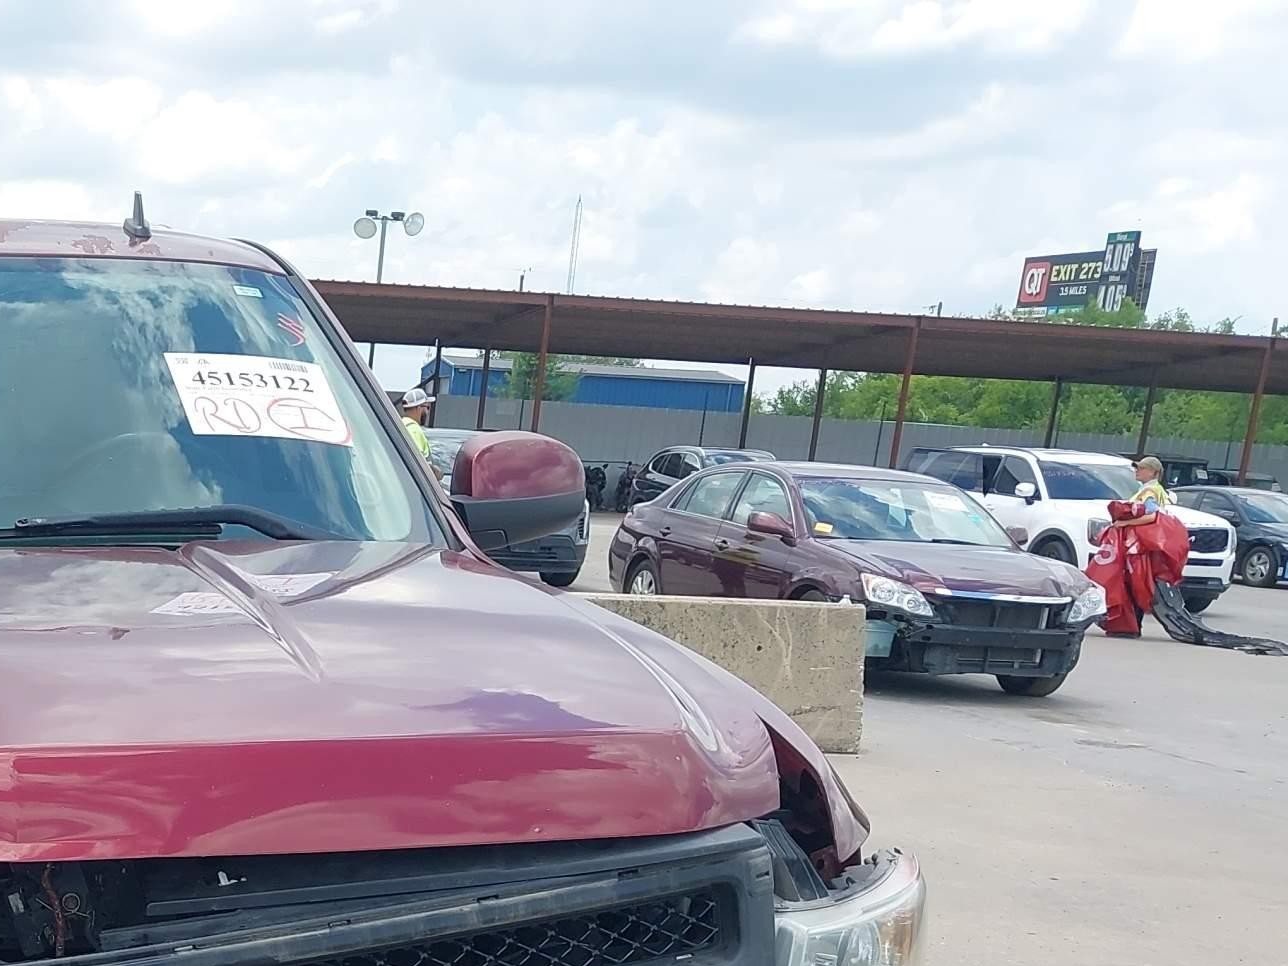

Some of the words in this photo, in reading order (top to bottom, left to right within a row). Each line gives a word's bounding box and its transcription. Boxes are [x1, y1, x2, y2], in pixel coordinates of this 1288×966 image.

[1025, 268, 1046, 297] QT
[1050, 264, 1080, 282] EXIT
[1079, 261, 1104, 280] 273
[1068, 285, 1088, 296] MILES
[192, 370, 315, 393] 45153122
